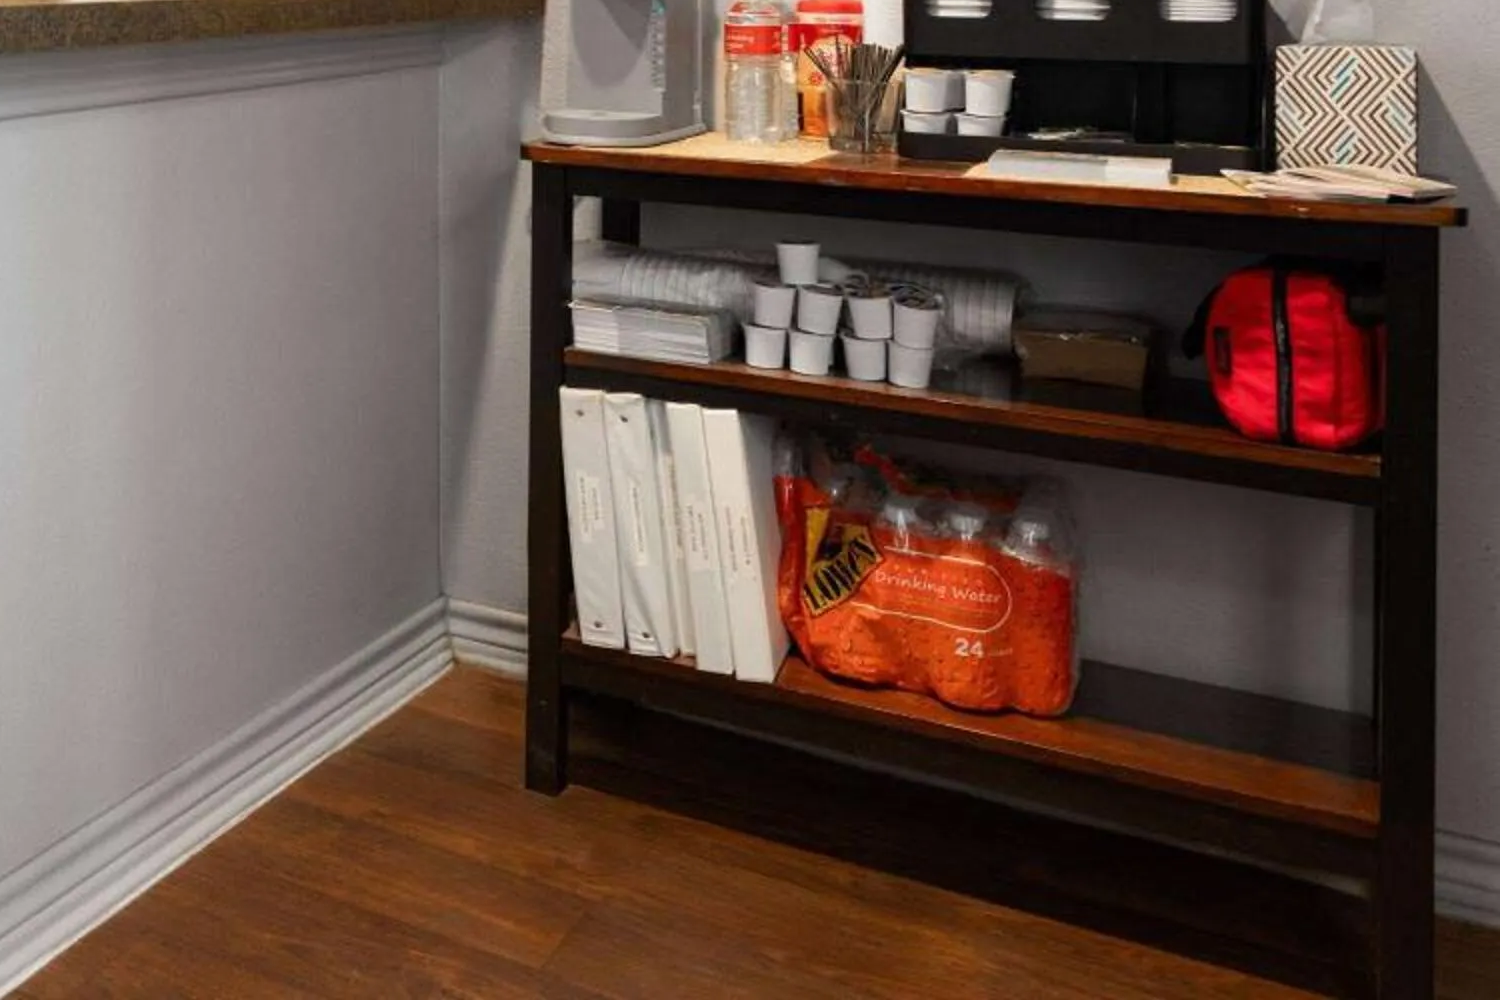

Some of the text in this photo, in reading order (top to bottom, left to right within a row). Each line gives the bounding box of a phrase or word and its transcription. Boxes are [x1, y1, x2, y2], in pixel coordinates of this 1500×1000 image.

[874, 568, 947, 599] Drinking
[951, 587, 1001, 604] Water
[954, 637, 984, 659] 24
